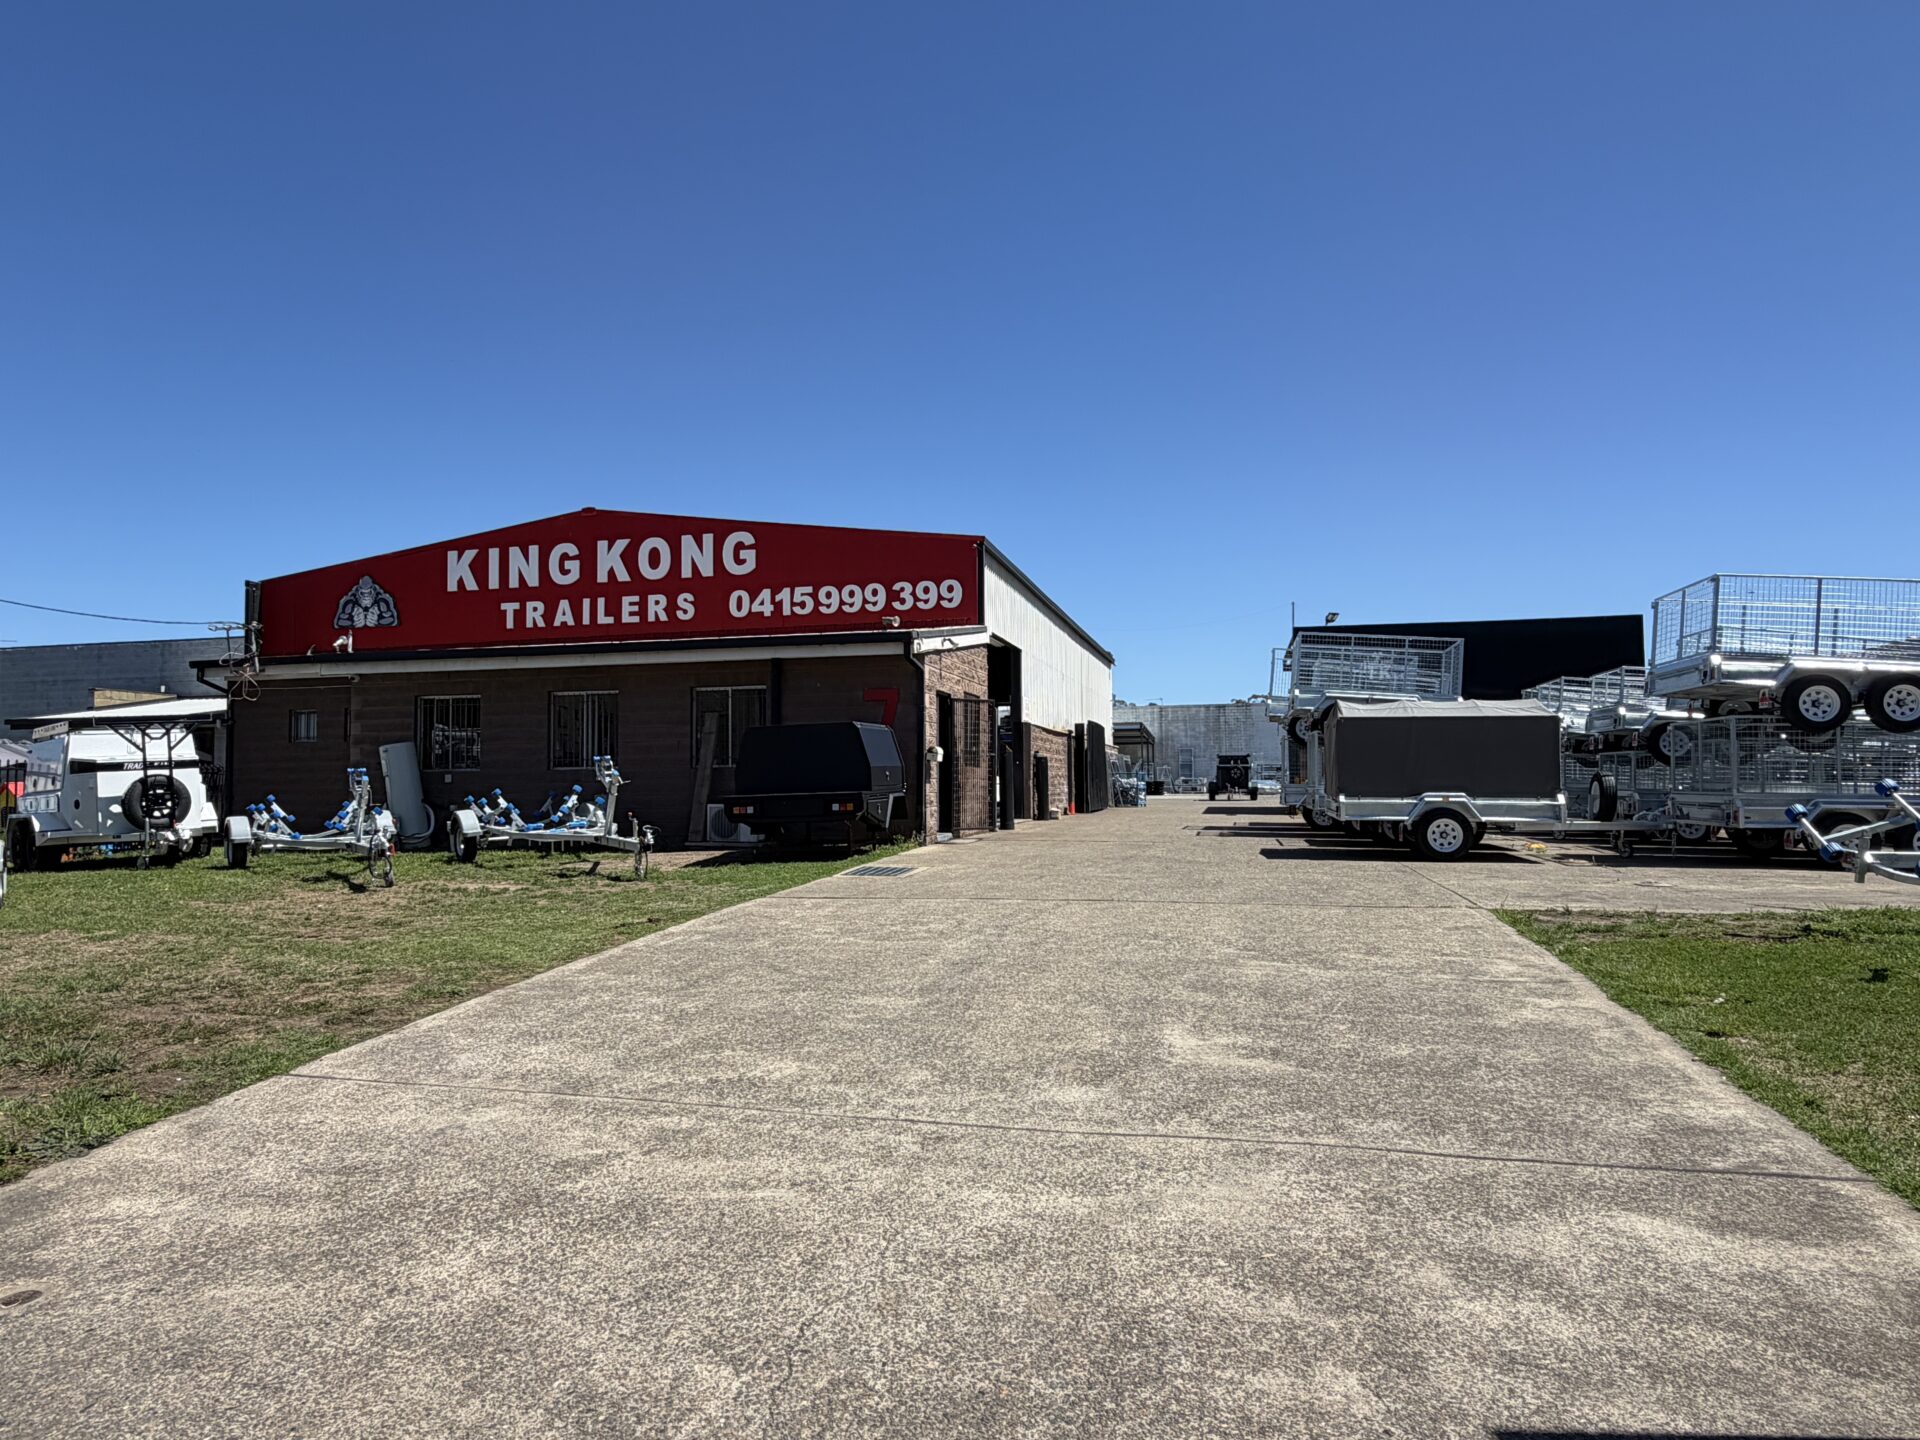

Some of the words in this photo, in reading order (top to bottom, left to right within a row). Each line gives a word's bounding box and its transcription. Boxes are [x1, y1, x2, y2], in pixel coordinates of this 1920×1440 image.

[447, 542, 581, 592] KING
[597, 531, 757, 583] KONG
[500, 592, 695, 629] TRAILERS
[863, 687, 899, 727] 7
